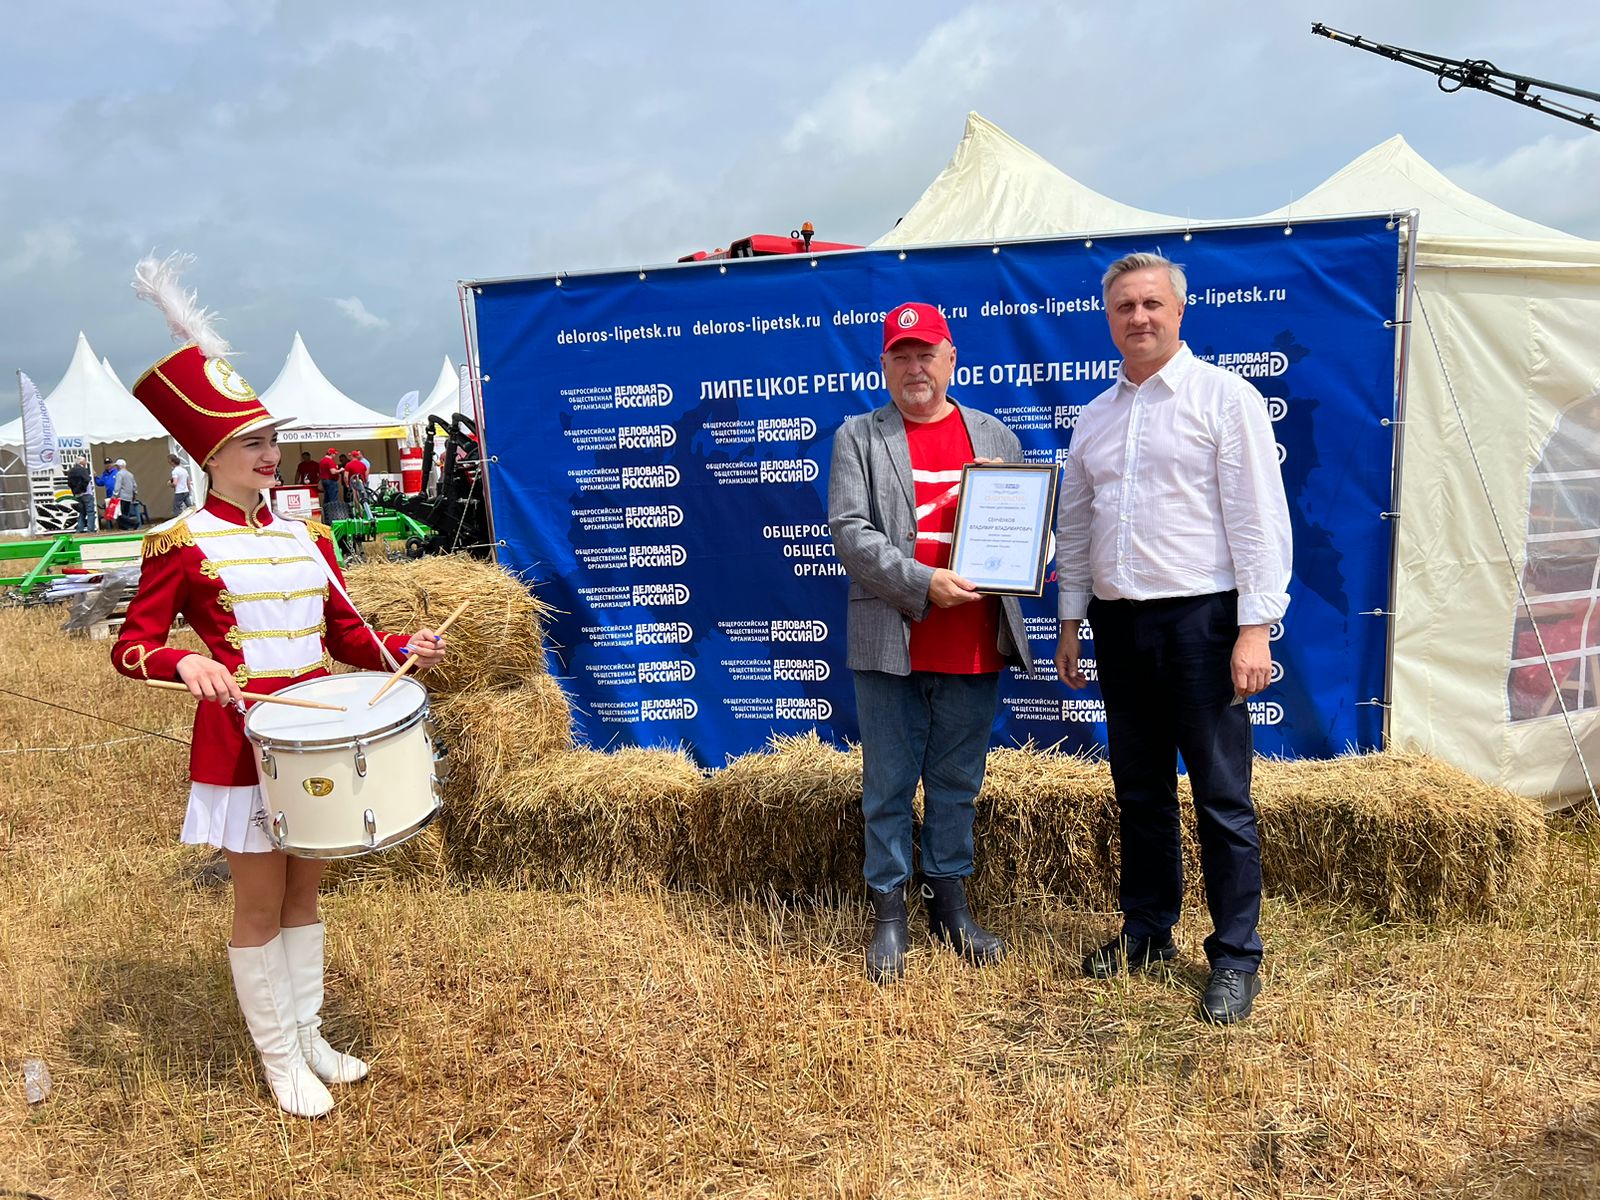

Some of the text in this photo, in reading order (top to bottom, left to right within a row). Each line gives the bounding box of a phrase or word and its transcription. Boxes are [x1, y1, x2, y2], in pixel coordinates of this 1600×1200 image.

[1184, 286, 1286, 307] s-lipetsk.ru
[981, 296, 1105, 316] deloros-lipetsk.
[692, 314, 821, 335] deloros-lipetsk.ru
[557, 323, 681, 344] deloros-lipetsk.ru
[1218, 352, 1269, 364] ДЕЛОВАЯ
[990, 360, 1119, 387] ОТДЕЛЕНИЕ
[561, 387, 611, 396] ОБЩЕРОССИЙСКАЯ
[615, 384, 656, 396] ДЕЛОВАЯ
[569, 395, 612, 403] ОБЩЕСТВЕННАЯ
[615, 394, 657, 408] РОССИЯ
[994, 406, 1052, 414] ОБЩЕРОССИЙСКАЯ
[1003, 414, 1052, 422] ОБЩЕСТВЕННАЯ
[703, 420, 754, 428] ОБЩЕРОССИЙСКАЯ
[758, 418, 799, 430] ДЕЛОВАЯ
[283, 432, 298, 440] ООО
[564, 428, 615, 436] ОБЩЕРОССИЙСКАЯ
[619, 425, 660, 437] ДЕЛОВАЯ
[758, 428, 800, 442] РОССИЯ
[619, 436, 661, 448] РОССИЯ
[706, 462, 757, 470] ОБЩЕРОССИЙСКАЯ
[760, 460, 801, 471] ДЕЛОВАЯ
[568, 468, 619, 476] ОБЩЕРОССИЙСКАЯ
[622, 466, 663, 478] ДЕЛОВАЯ
[760, 469, 802, 483] РОССИЯ
[622, 475, 664, 489] РОССИЯ
[572, 508, 622, 516] ОБЩЕРОССИЙСКАЯ
[626, 506, 667, 517] ДЕЛОВАЯ
[626, 515, 668, 528] РОССИЯ
[575, 547, 626, 555] ОБЩЕРОССИЙСКАЯ
[630, 545, 671, 556] ДЕЛОВАЯ
[630, 554, 672, 567] РОССИЯ
[578, 586, 629, 594] ОБЩЕРОССИЙСКАЯ
[633, 584, 674, 595] ДЕЛОВАЯ
[586, 593, 630, 601] ОБЩЕСТВЕННАЯ
[633, 593, 675, 606] РОССИЯ
[582, 625, 632, 633] ОБЩЕРОССИЙСКАЯ
[636, 622, 677, 634] ДЕЛОВАЯ
[771, 621, 812, 630] ДЕЛОВАЯ
[636, 631, 678, 645] РОССИЯ
[771, 630, 813, 641] РОССИЯ
[639, 661, 680, 672] ДЕЛОВАЯ
[774, 660, 815, 669] ДЕЛОВАЯ
[594, 670, 636, 678] ОБЩЕСТВЕННАЯ
[639, 670, 681, 683] РОССИЯ
[774, 669, 816, 680] РОССИЯ
[642, 699, 683, 710] ДЕЛОВАЯ
[776, 698, 817, 708] ДЕЛОВАЯ
[642, 707, 684, 721] РОССИЯ
[776, 708, 818, 720] РОССИЯ
[1062, 710, 1107, 722] РОССИЯ
